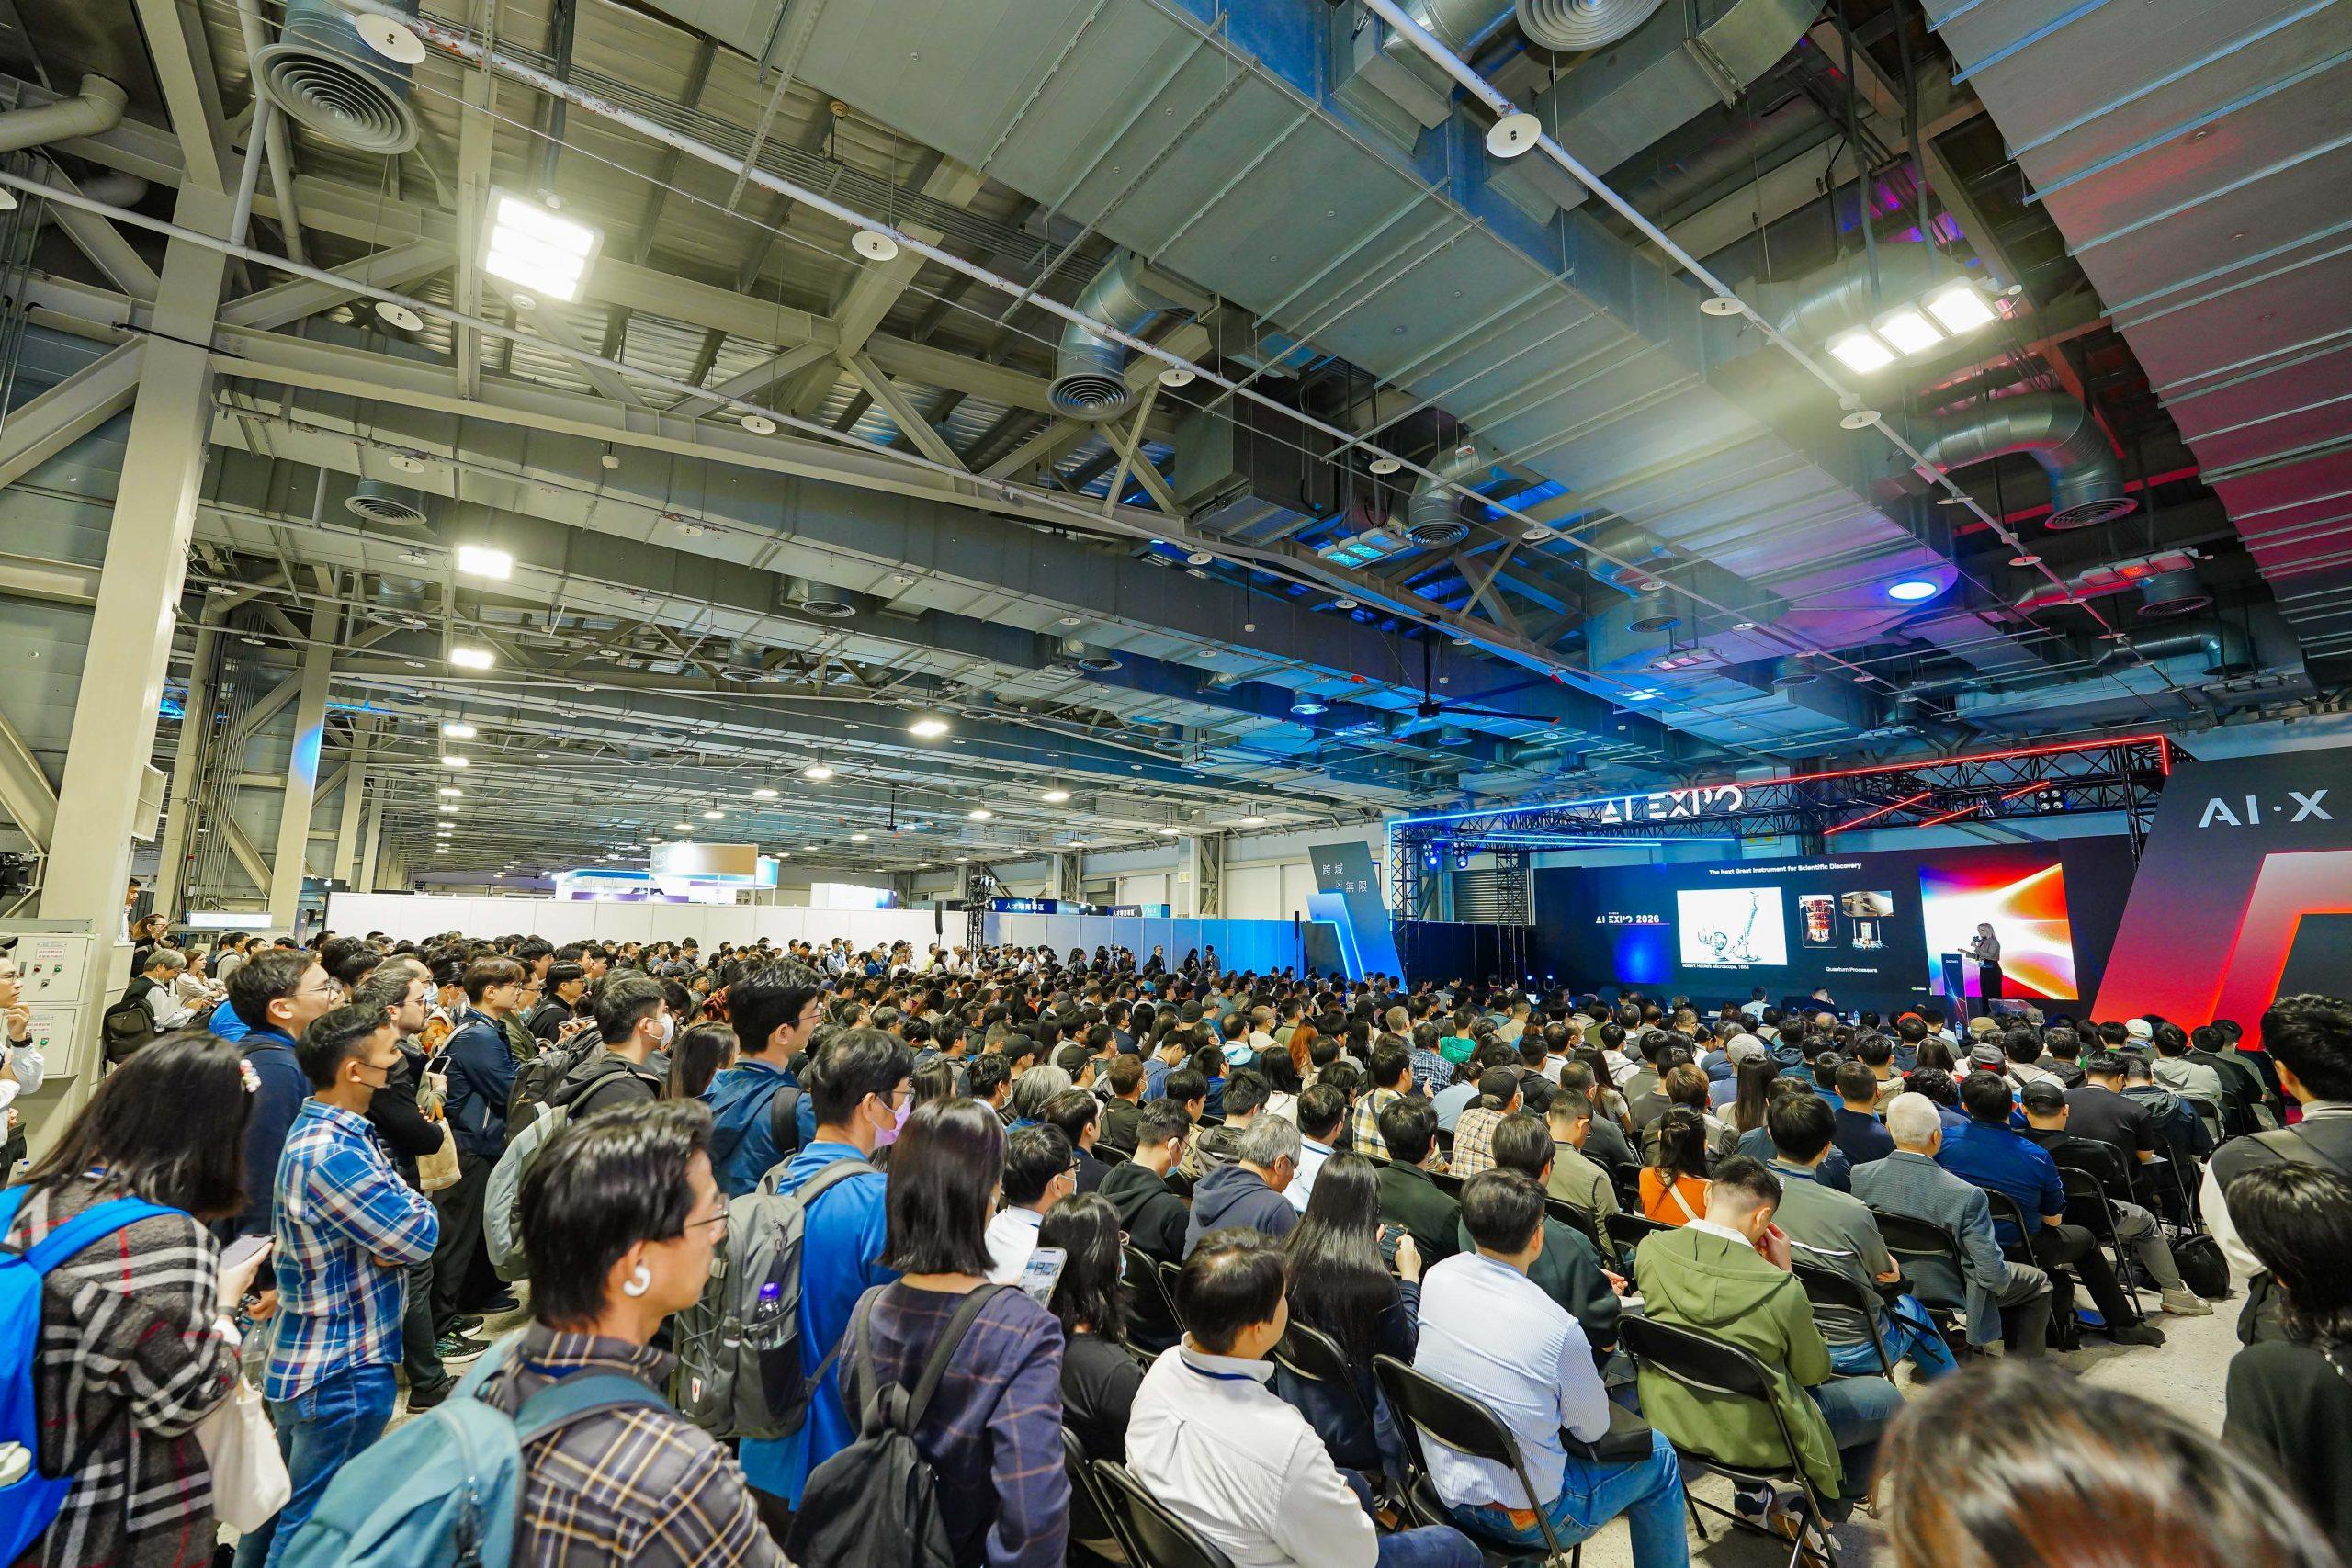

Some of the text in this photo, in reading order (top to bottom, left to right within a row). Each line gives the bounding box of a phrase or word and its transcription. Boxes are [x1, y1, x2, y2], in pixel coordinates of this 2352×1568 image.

[1601, 784, 1743, 824] AI EXPO
[1322, 863, 1343, 876] 跨域
[1345, 880, 1367, 893] 無限
[1595, 914, 1660, 924] AI EXPO 2026
